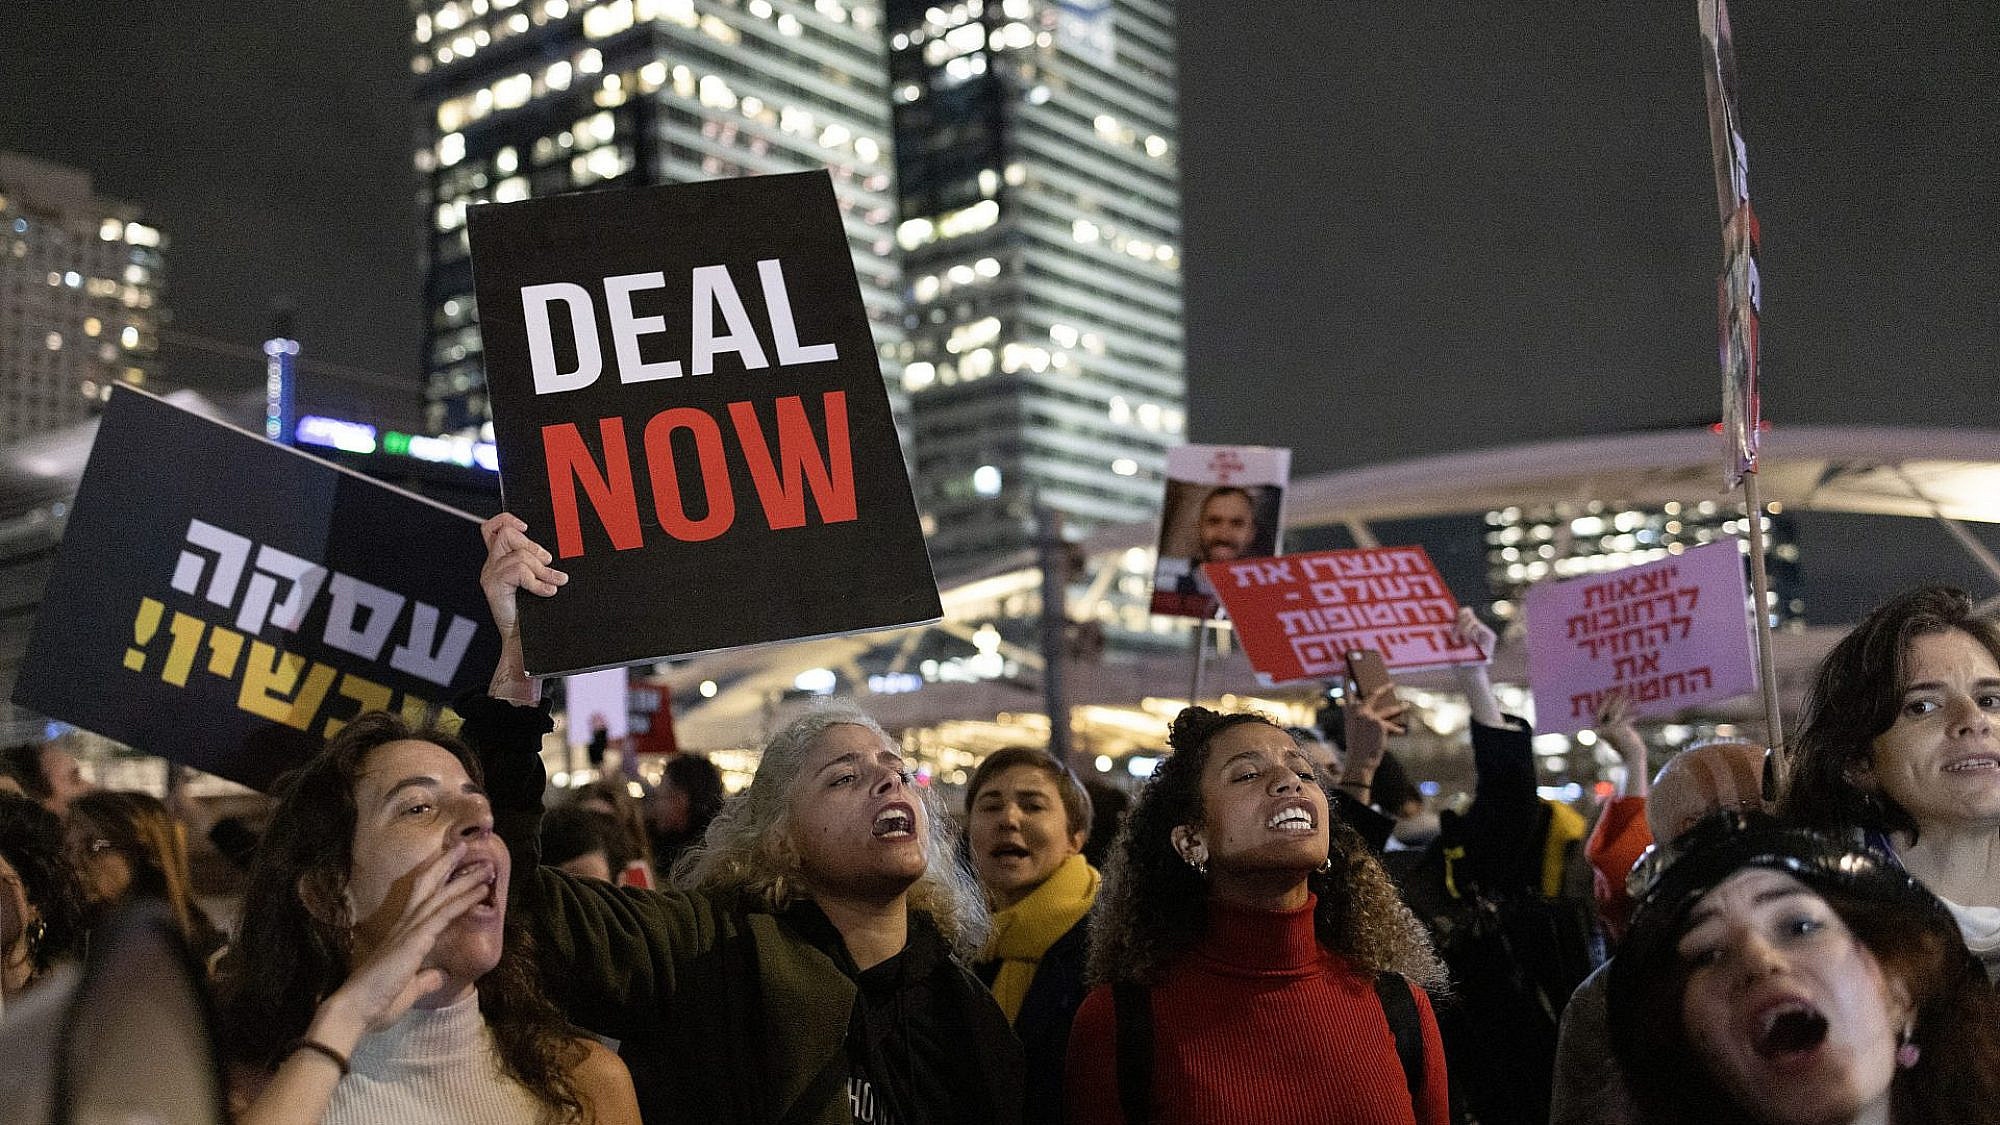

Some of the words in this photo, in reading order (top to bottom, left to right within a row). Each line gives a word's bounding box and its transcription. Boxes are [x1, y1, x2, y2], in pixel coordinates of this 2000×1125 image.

[520, 258, 839, 396] DEAL
[541, 390, 858, 559] NOW
[1229, 561, 1296, 588] את
[1301, 552, 1428, 579] תעצרו
[170, 518, 477, 688] עסקה
[1310, 574, 1442, 604] העולם
[1584, 566, 1678, 609] יוצאות
[1276, 598, 1455, 635] החטופות
[1567, 585, 1699, 638] לרחובות
[1578, 614, 1691, 661] להחזיר
[1613, 650, 1661, 680] את
